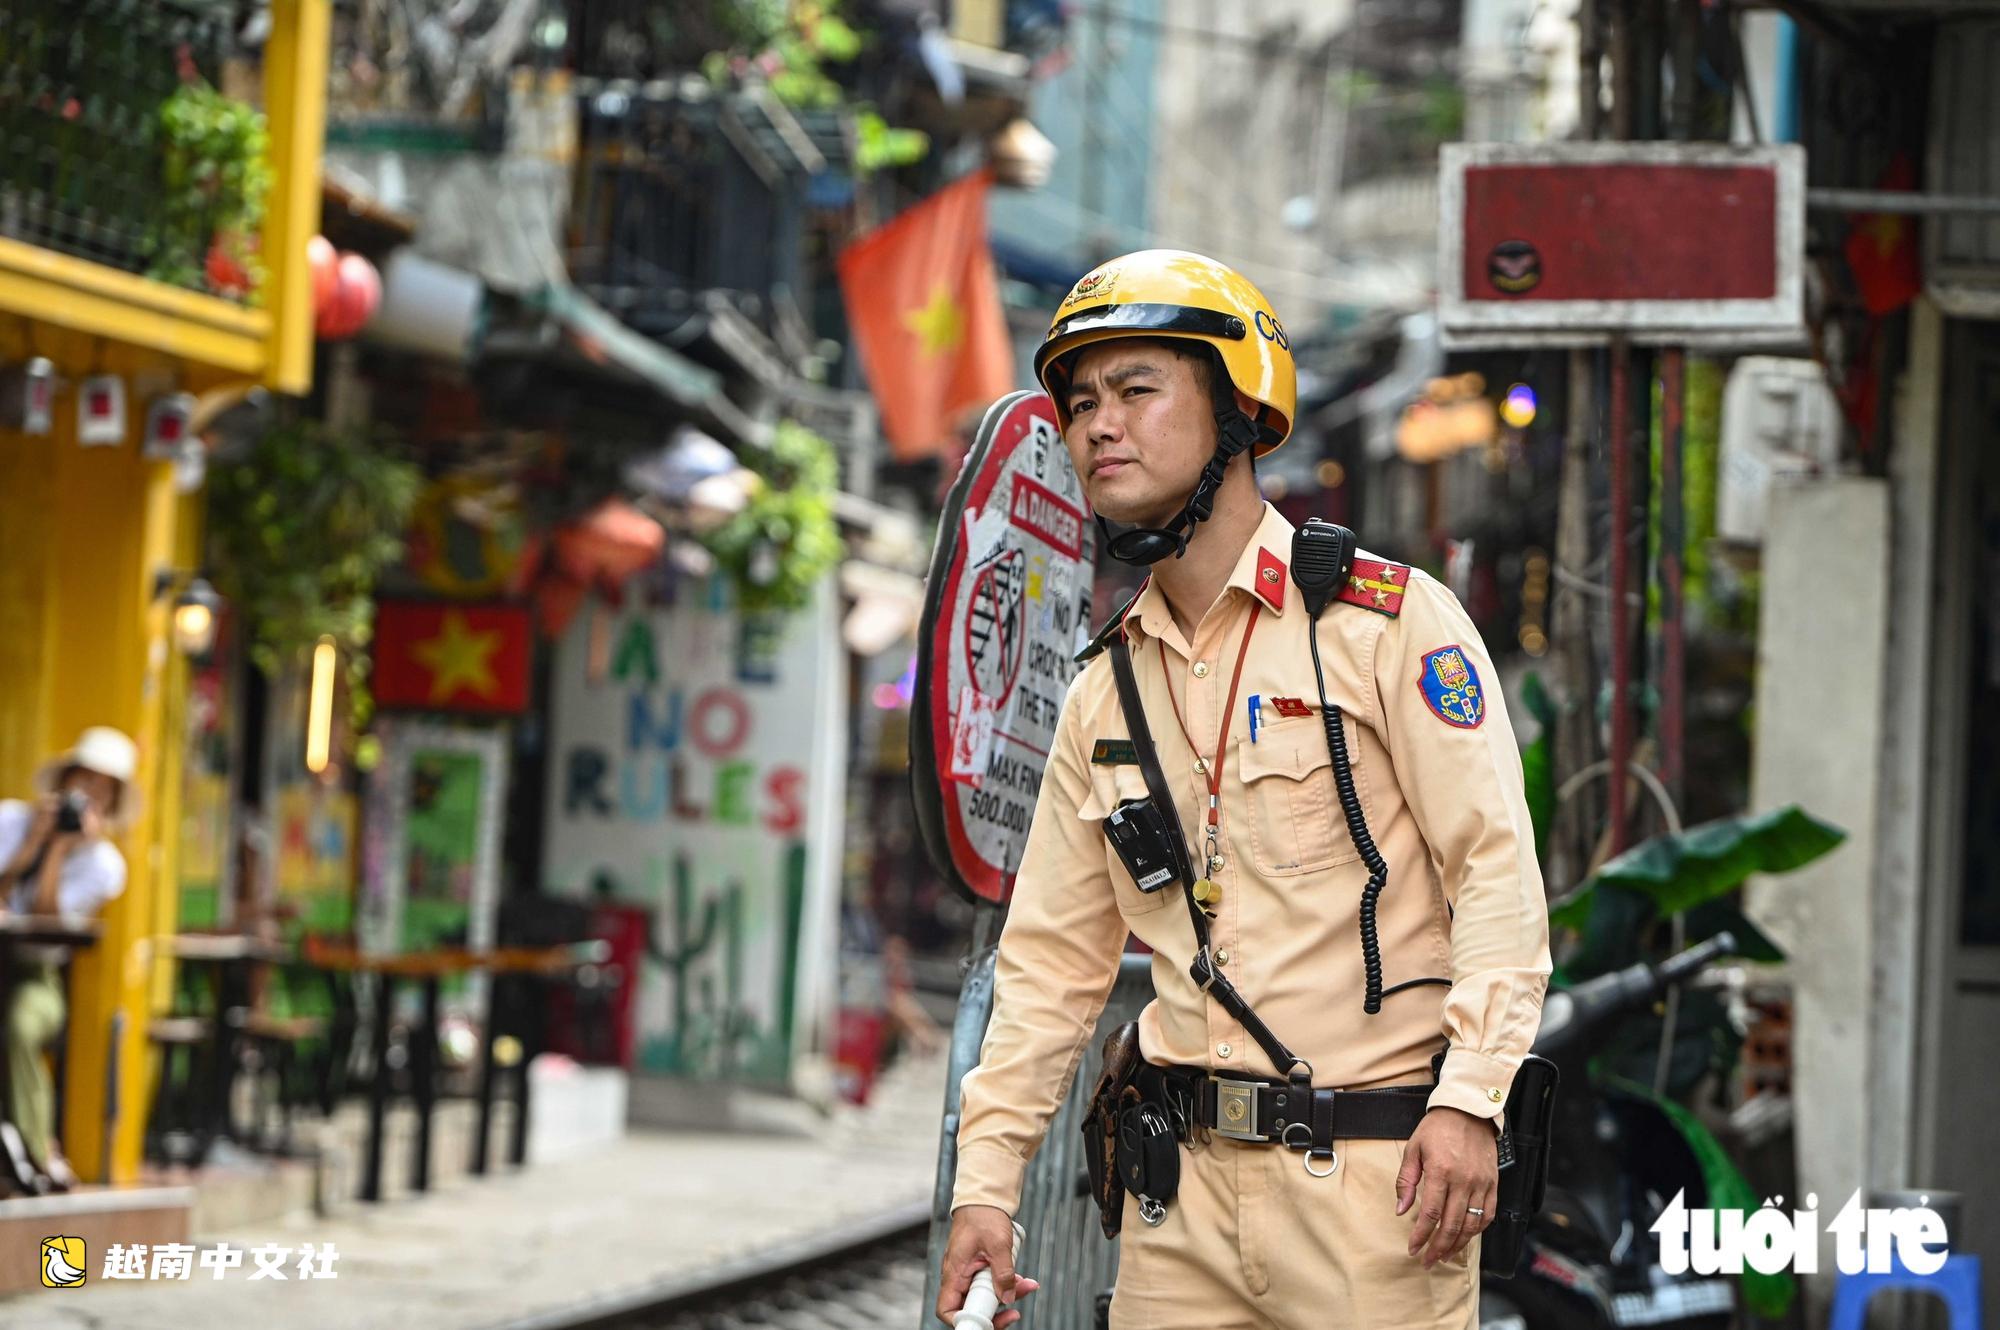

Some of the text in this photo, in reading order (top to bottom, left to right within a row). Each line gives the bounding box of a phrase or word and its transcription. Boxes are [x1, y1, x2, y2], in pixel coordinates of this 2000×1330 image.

[1029, 492, 1078, 551] DANGER
[1053, 600, 1070, 635] NO
[1018, 685, 1038, 725] THE
[1440, 691, 1460, 707] CS
[629, 687, 752, 759] NO
[986, 751, 1018, 787] MAX
[566, 746, 806, 836] RULES
